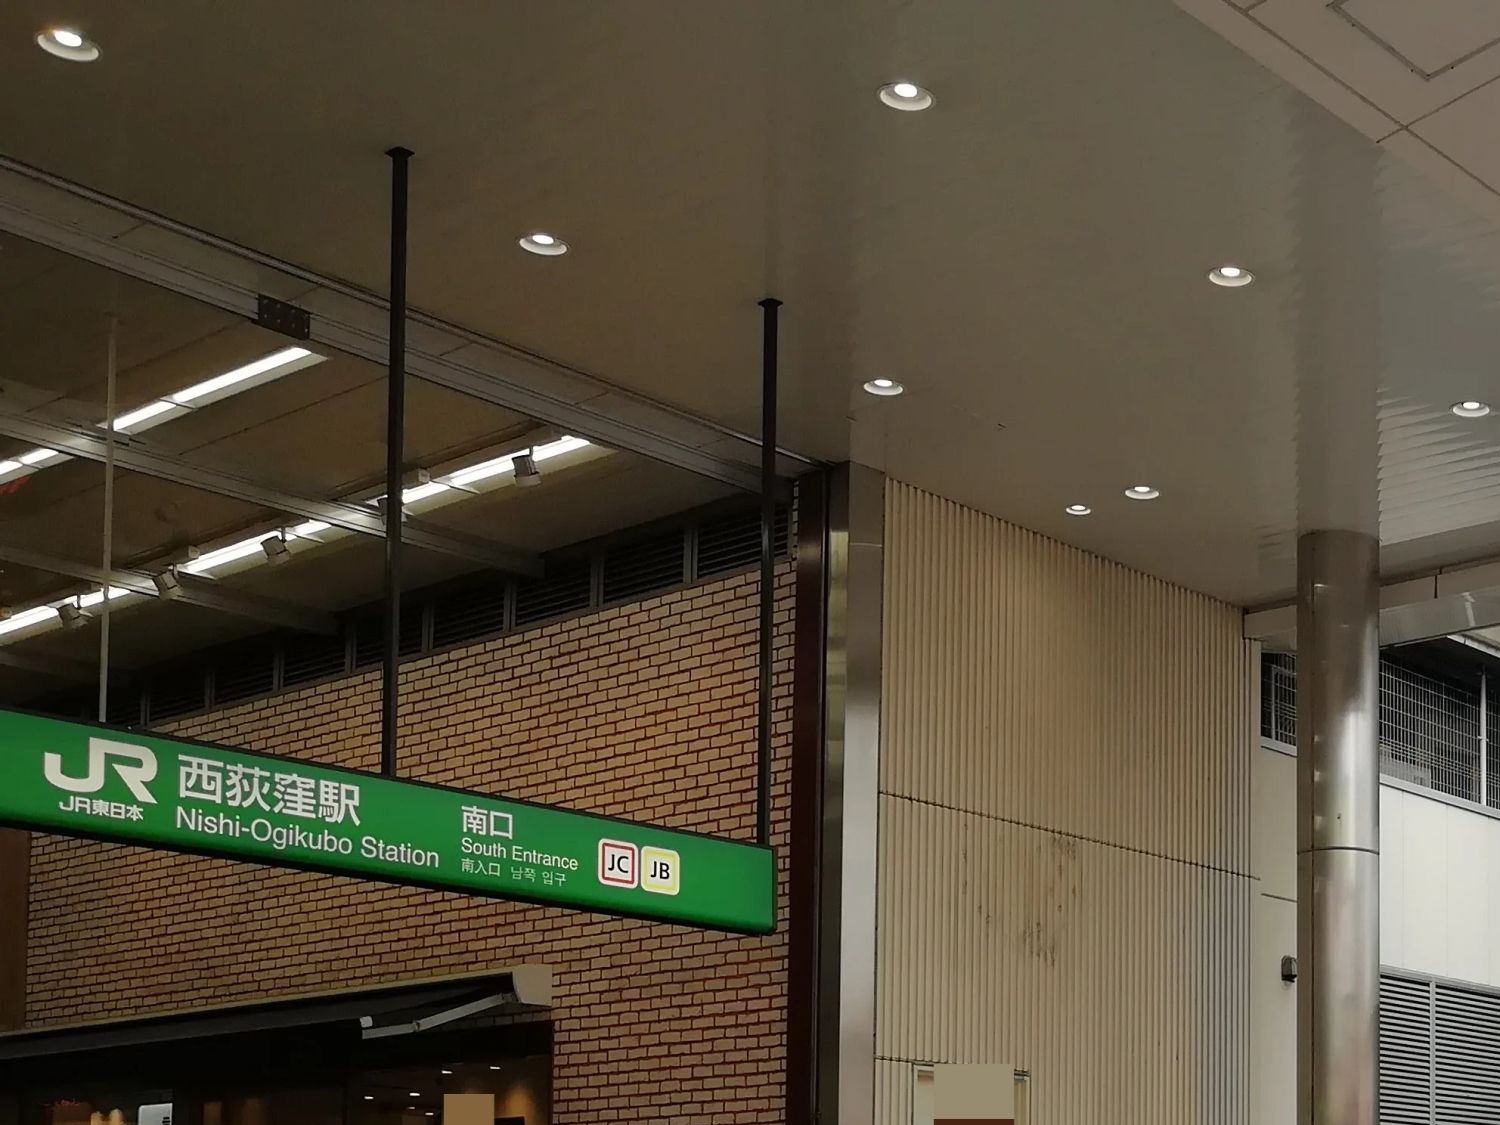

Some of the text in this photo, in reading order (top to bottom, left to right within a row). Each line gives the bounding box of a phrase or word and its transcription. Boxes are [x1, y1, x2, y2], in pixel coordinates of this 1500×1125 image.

[44, 737, 158, 804] JR
[178, 754, 361, 826] 西荻窪駅
[59, 796, 144, 821] JR東日本
[461, 806, 513, 839] 南口
[176, 806, 440, 868] Nishi-Ogikubo Station
[461, 837, 579, 870] South Entrance
[461, 858, 501, 877] 南入口
[608, 853, 629, 873] JC
[511, 866, 567, 887] 남쪽 입구
[650, 861, 670, 880] JB
